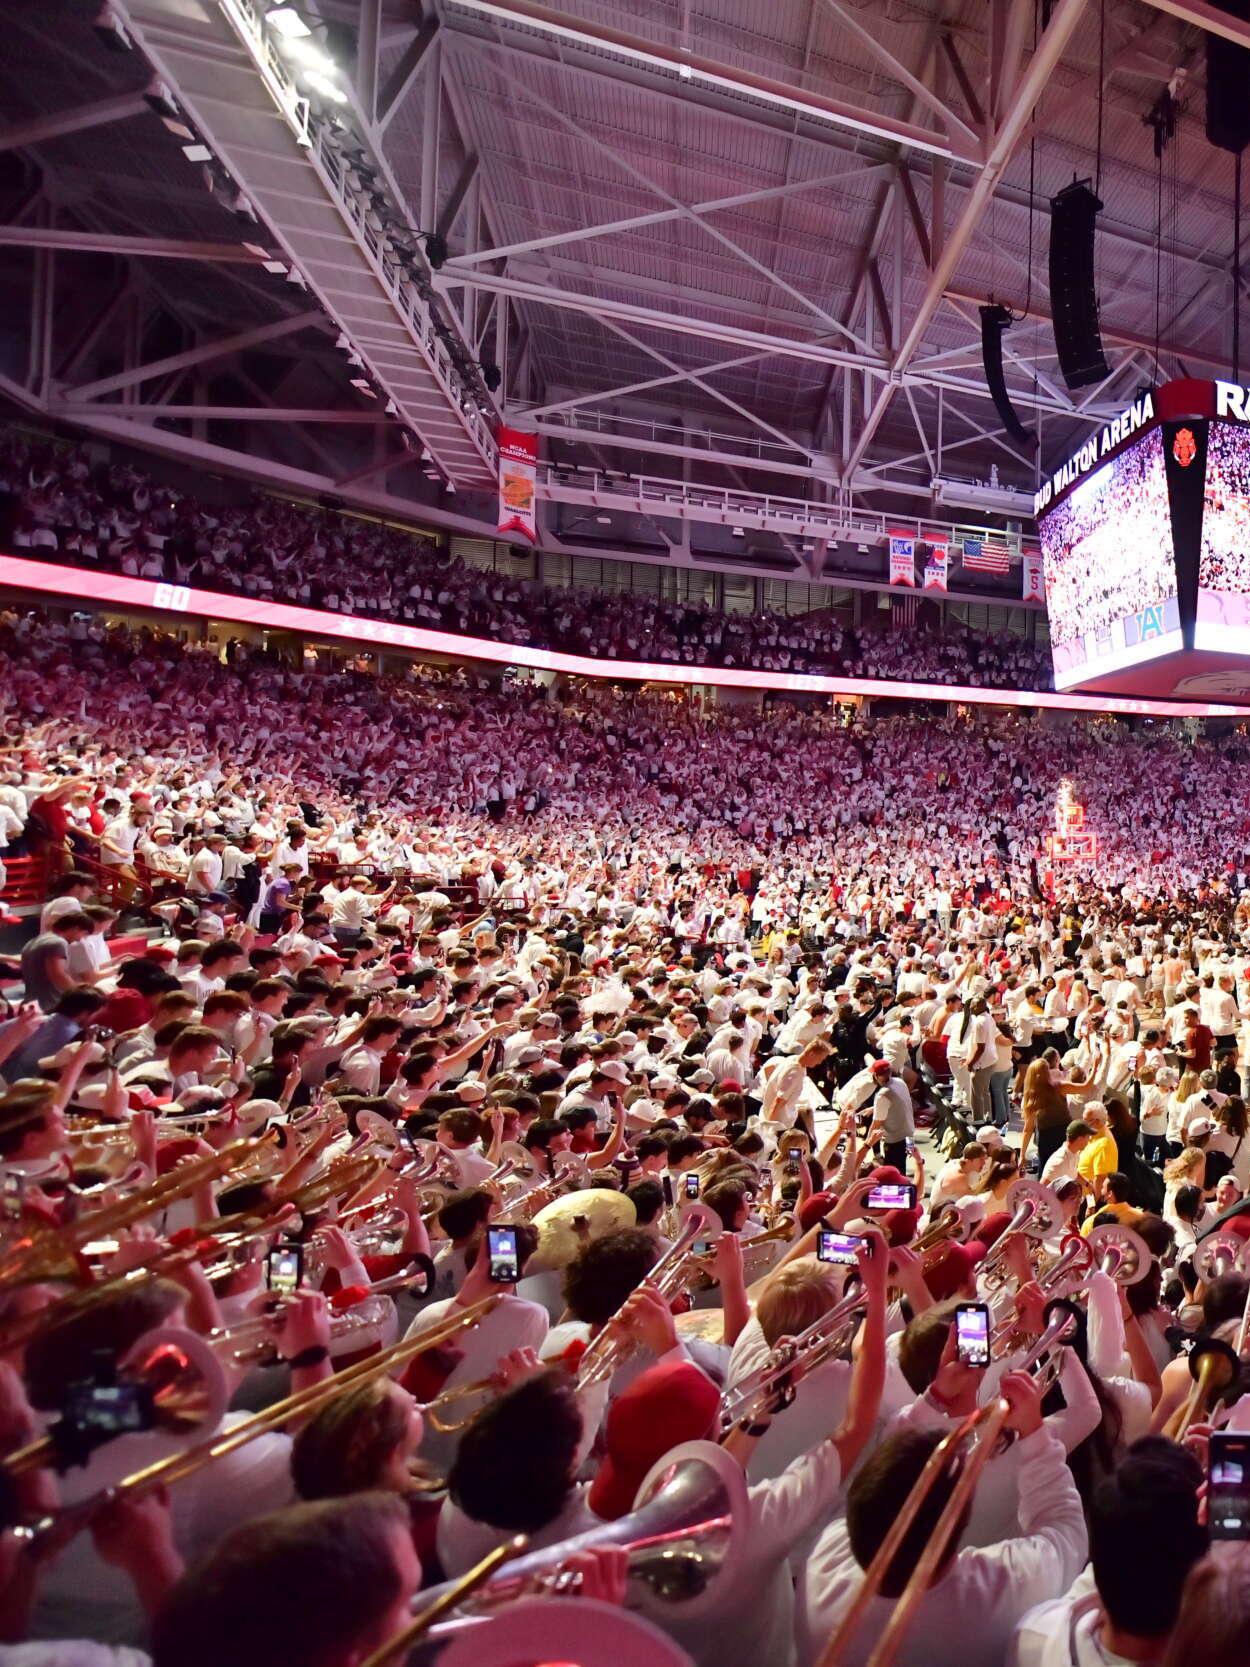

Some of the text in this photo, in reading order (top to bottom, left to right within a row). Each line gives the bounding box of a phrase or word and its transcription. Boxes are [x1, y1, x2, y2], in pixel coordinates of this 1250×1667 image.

[1034, 392, 1154, 516] BUD WALTON ARENA
